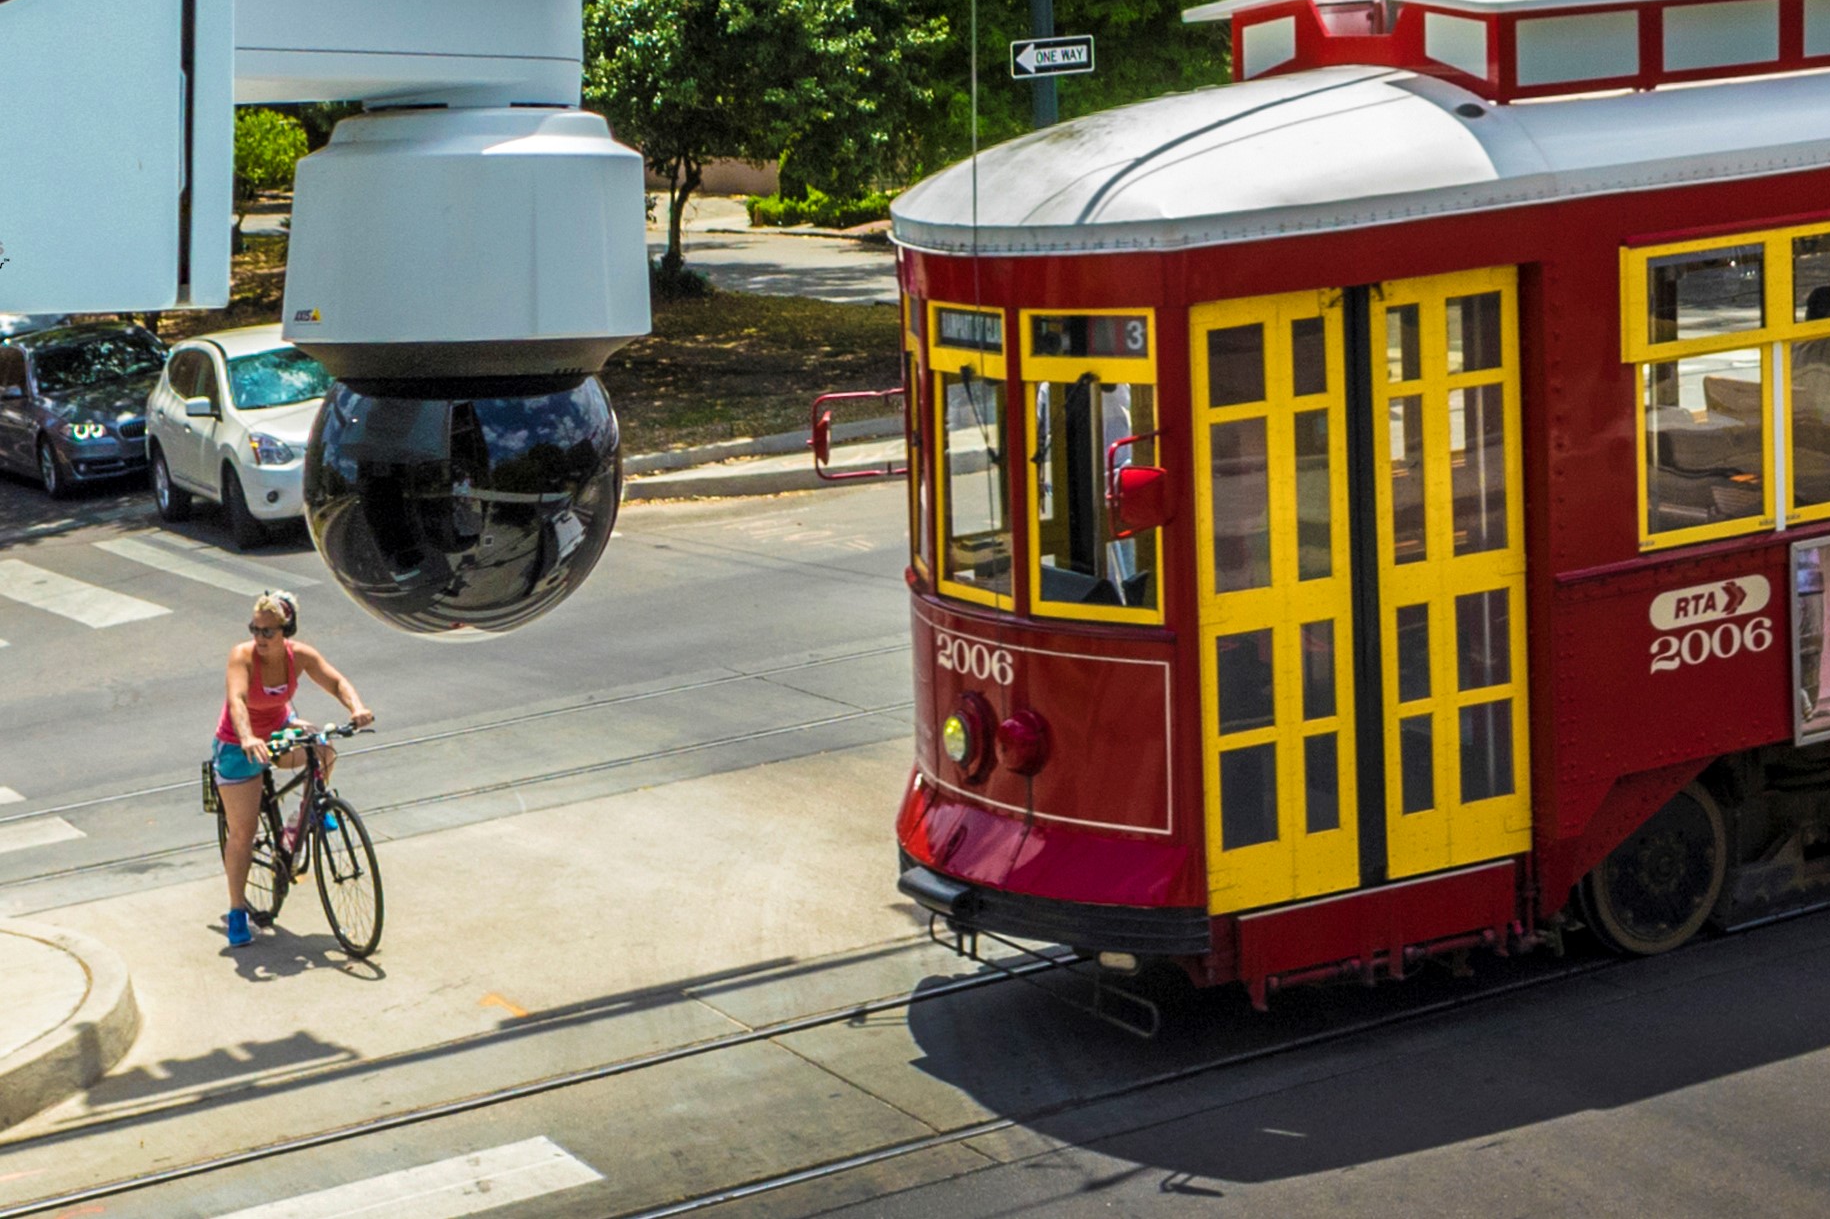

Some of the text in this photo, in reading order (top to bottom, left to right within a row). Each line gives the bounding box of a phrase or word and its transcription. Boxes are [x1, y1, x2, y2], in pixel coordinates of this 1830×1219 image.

[1036, 47, 1084, 64] ONE WAY
[1126, 320, 1144, 351] 3
[1673, 591, 1717, 620] RTA
[937, 632, 1014, 686] 2006
[1649, 616, 1773, 675] 2006
